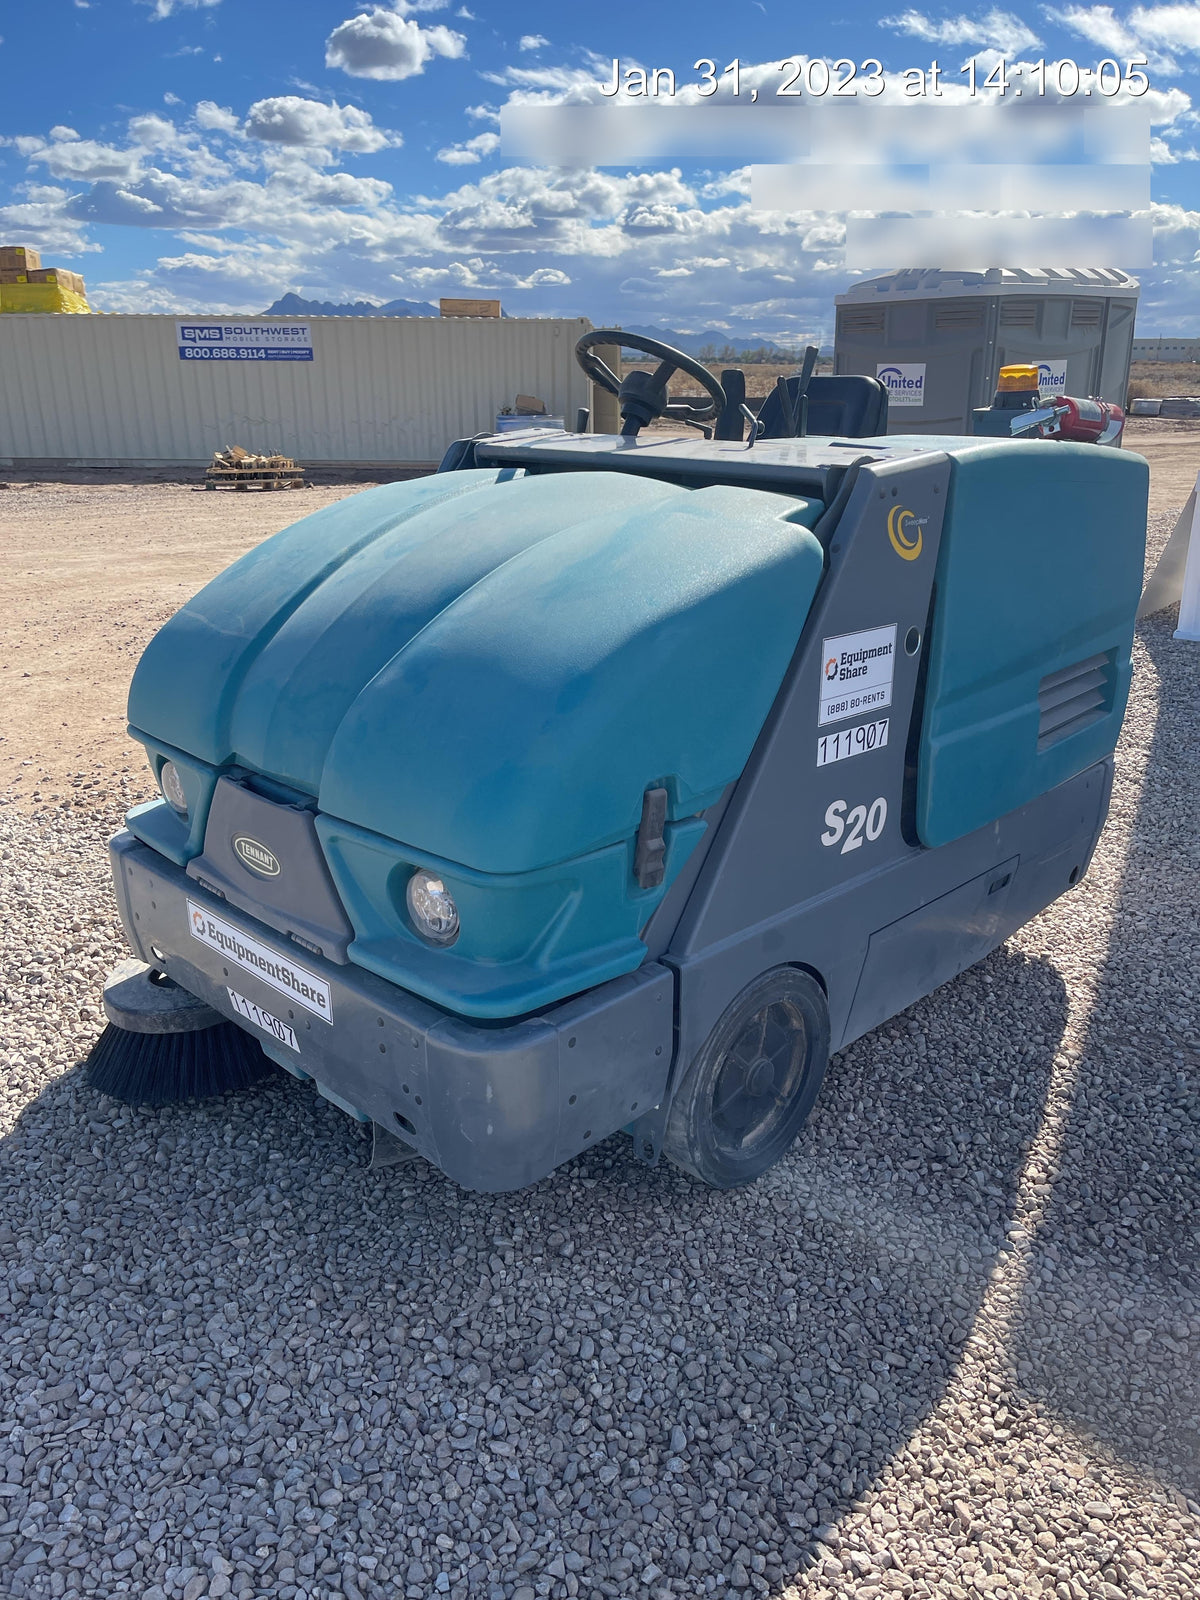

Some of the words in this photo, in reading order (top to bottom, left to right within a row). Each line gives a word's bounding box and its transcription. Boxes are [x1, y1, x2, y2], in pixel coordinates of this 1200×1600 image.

[184, 328, 221, 340] SMS
[224, 326, 307, 336] SOUTHWEST
[185, 347, 266, 359] 800.686.9114
[882, 375, 923, 389] United
[894, 389, 922, 397] SERVICES
[840, 642, 893, 667] Equipment
[839, 665, 868, 681] Share
[827, 700, 848, 716] (888)
[820, 720, 888, 763] 111907
[820, 796, 888, 855] S20
[240, 840, 275, 870] TENNANT
[206, 920, 327, 1010] EquipmentShare
[230, 990, 295, 1047] 111907
